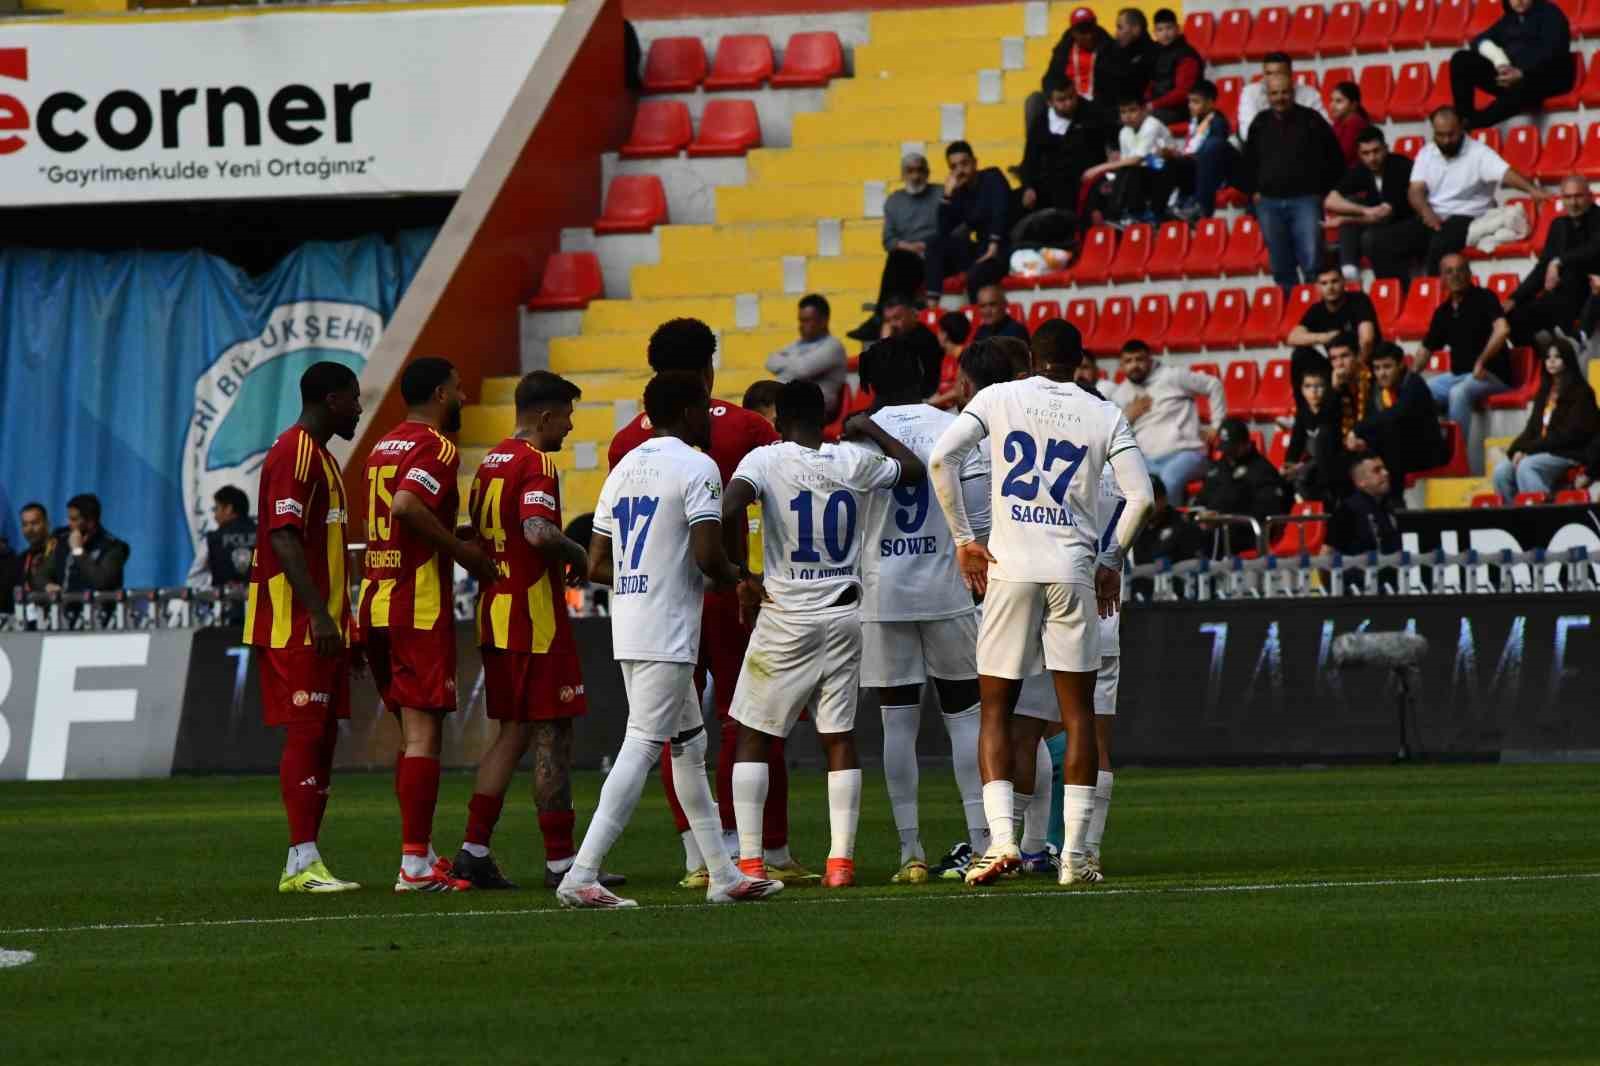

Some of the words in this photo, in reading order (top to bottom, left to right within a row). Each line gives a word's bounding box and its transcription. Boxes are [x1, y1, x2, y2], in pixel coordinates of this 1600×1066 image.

[38, 160, 209, 188] "Gayrimenkulde
[215, 158, 261, 179] Yeni
[267, 156, 375, 181] Ortağınız"
[367, 464, 399, 542] 15
[1001, 430, 1089, 506] 27
[612, 495, 660, 571] 17
[790, 489, 857, 563] 10
[893, 480, 929, 534] 9
[881, 535, 937, 557] SOWE
